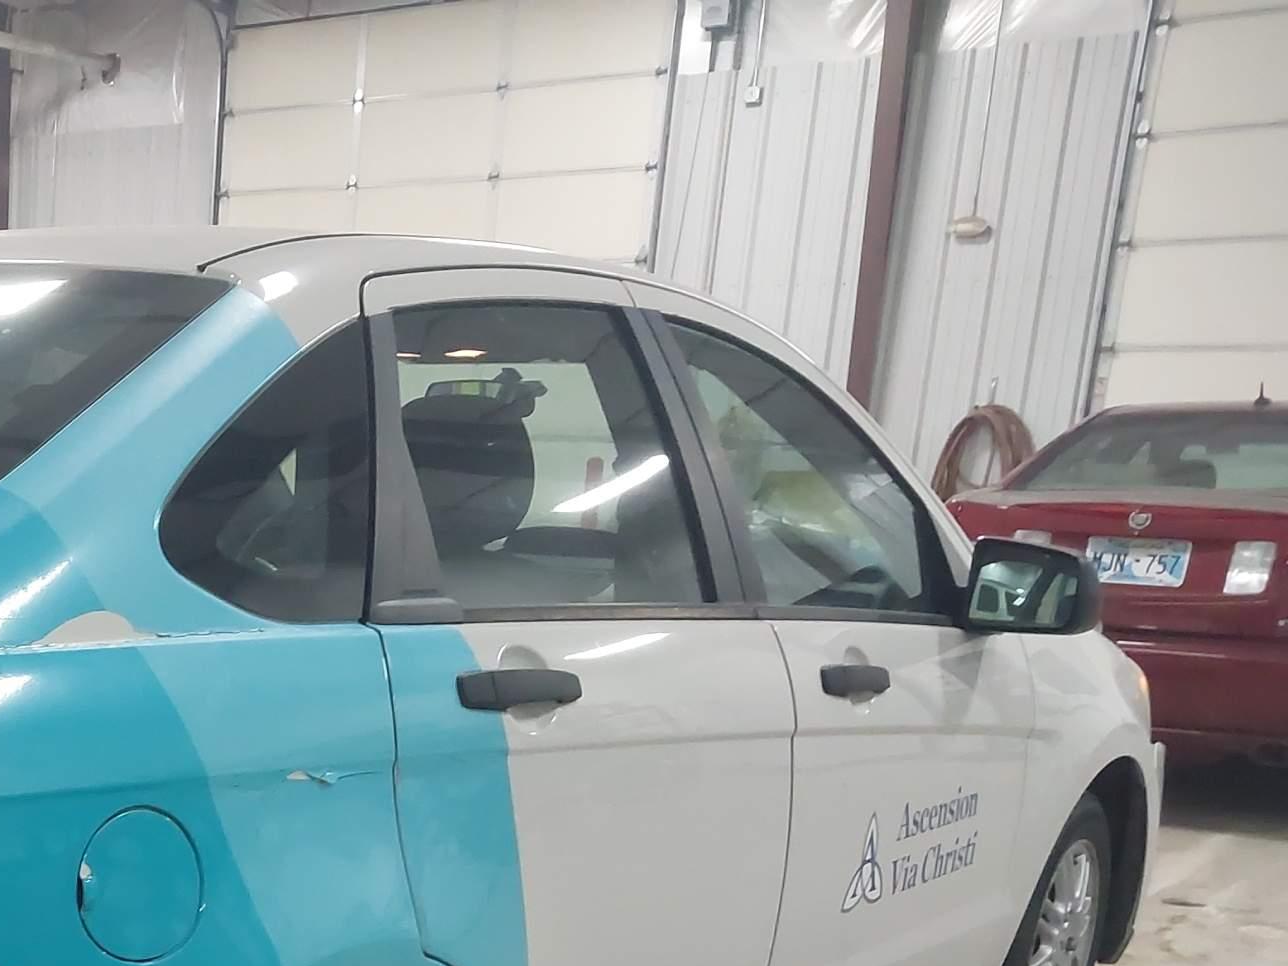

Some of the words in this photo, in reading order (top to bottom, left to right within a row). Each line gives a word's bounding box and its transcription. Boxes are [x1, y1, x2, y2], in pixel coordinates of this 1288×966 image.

[896, 786, 978, 842] Ascension
[891, 854, 918, 895] Via
[921, 830, 978, 884] Christi
